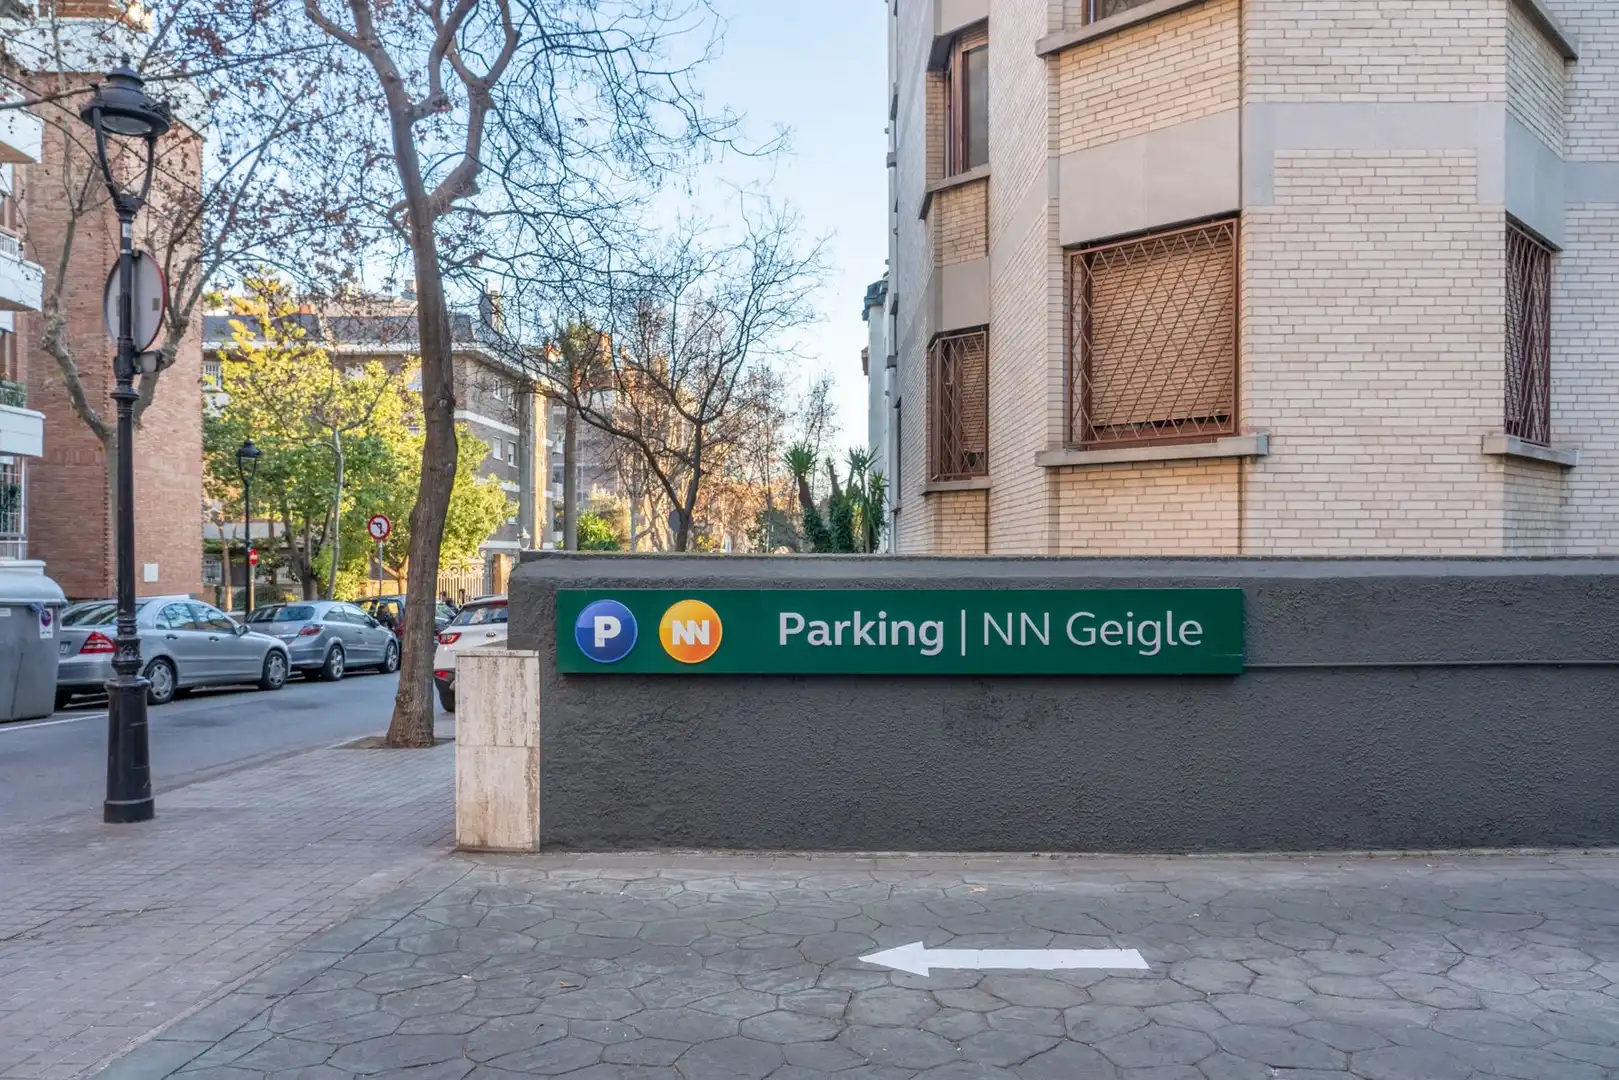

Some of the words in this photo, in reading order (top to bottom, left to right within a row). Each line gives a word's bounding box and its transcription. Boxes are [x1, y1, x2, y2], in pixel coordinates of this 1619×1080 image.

[594, 615, 621, 648] P
[671, 619, 710, 645] NN
[778, 610, 944, 657] Parking
[984, 612, 1050, 646] NN
[1065, 610, 1204, 657] Geigle
